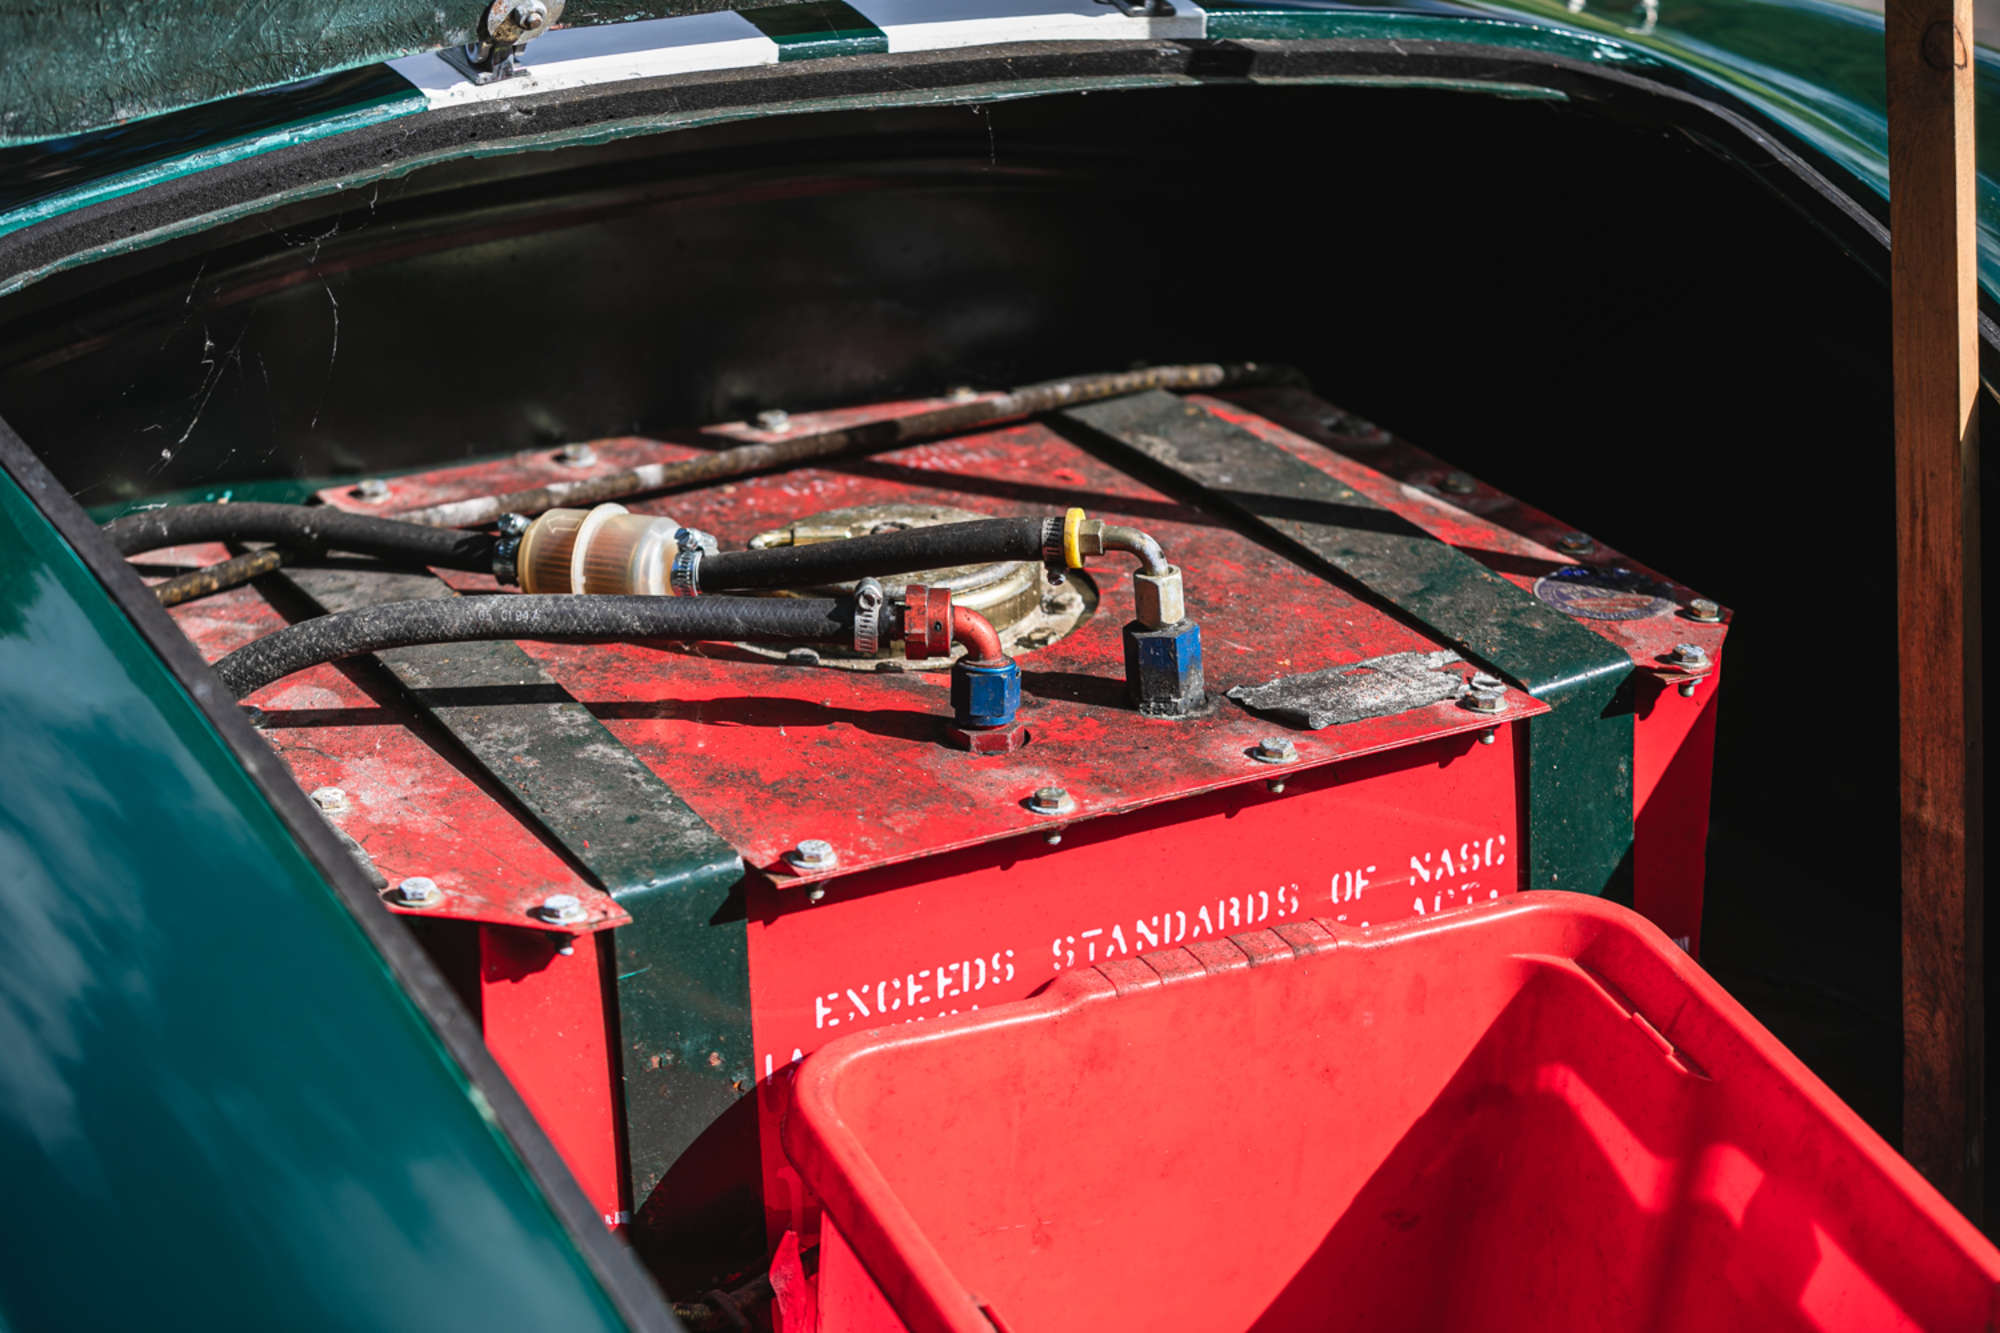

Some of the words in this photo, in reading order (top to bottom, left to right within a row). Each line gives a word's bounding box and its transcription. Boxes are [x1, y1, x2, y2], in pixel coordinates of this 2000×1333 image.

[815, 950, 1015, 1029] EXCEEDS
[1052, 882, 1299, 971] STANDARDS
[1331, 865, 1377, 904] OF
